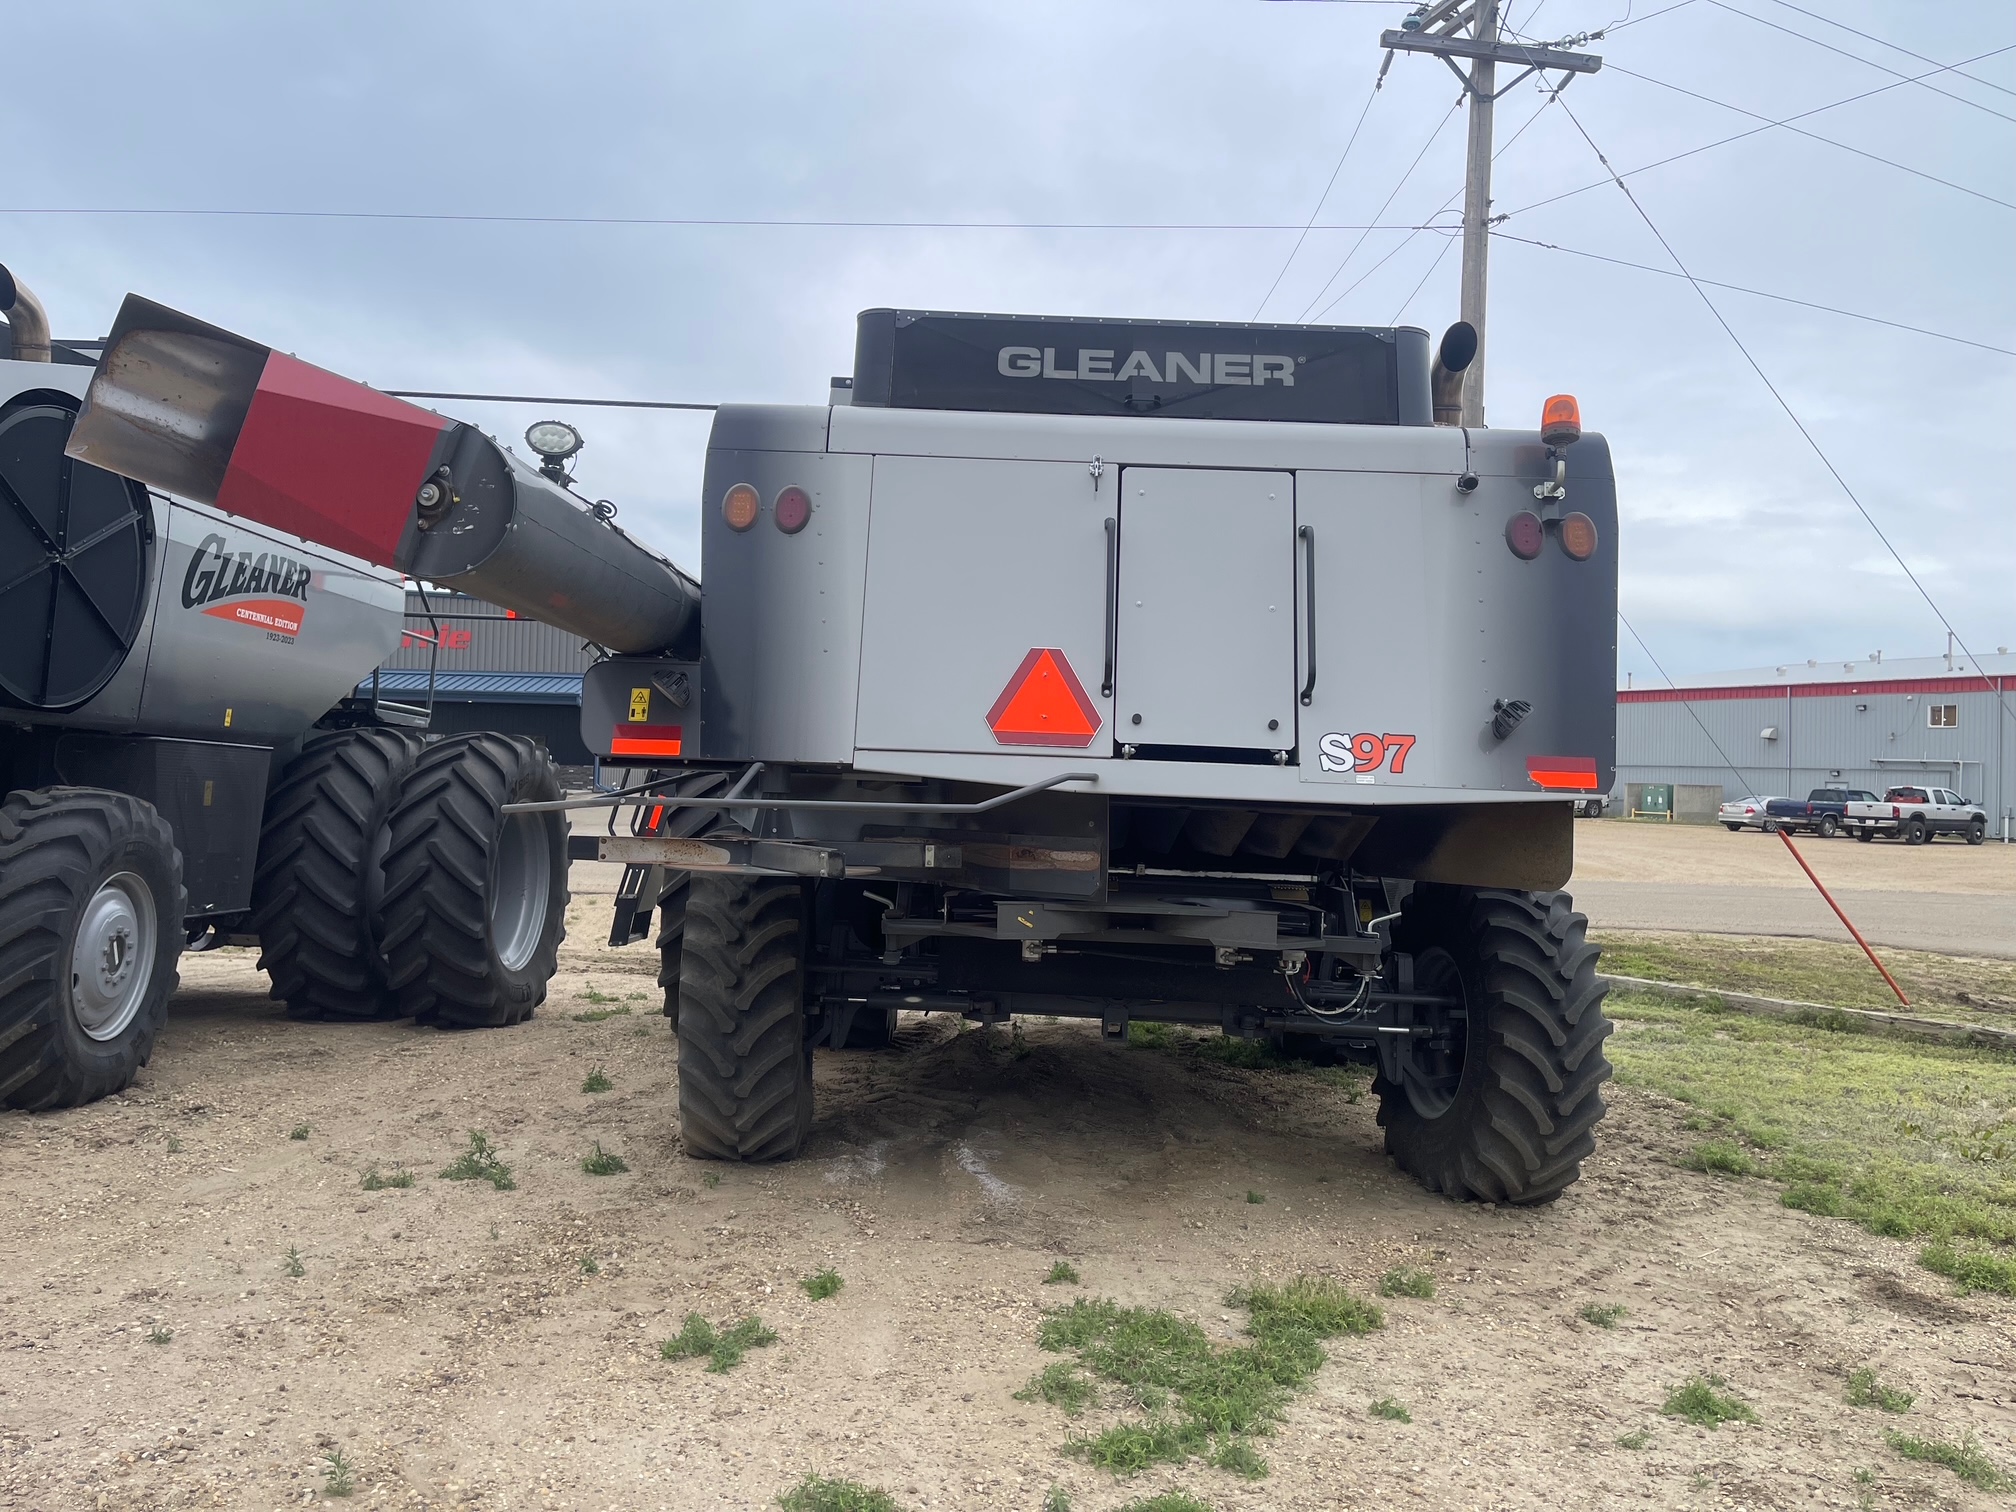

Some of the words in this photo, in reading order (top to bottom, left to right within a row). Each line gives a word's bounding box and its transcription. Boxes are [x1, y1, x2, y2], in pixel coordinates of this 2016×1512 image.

[182, 533, 311, 609] GLEANER
[236, 608, 274, 625] CENTENNIAL
[274, 617, 299, 631] EDITION
[266, 632, 295, 645] 1923-2023
[1319, 732, 1416, 773] S97
